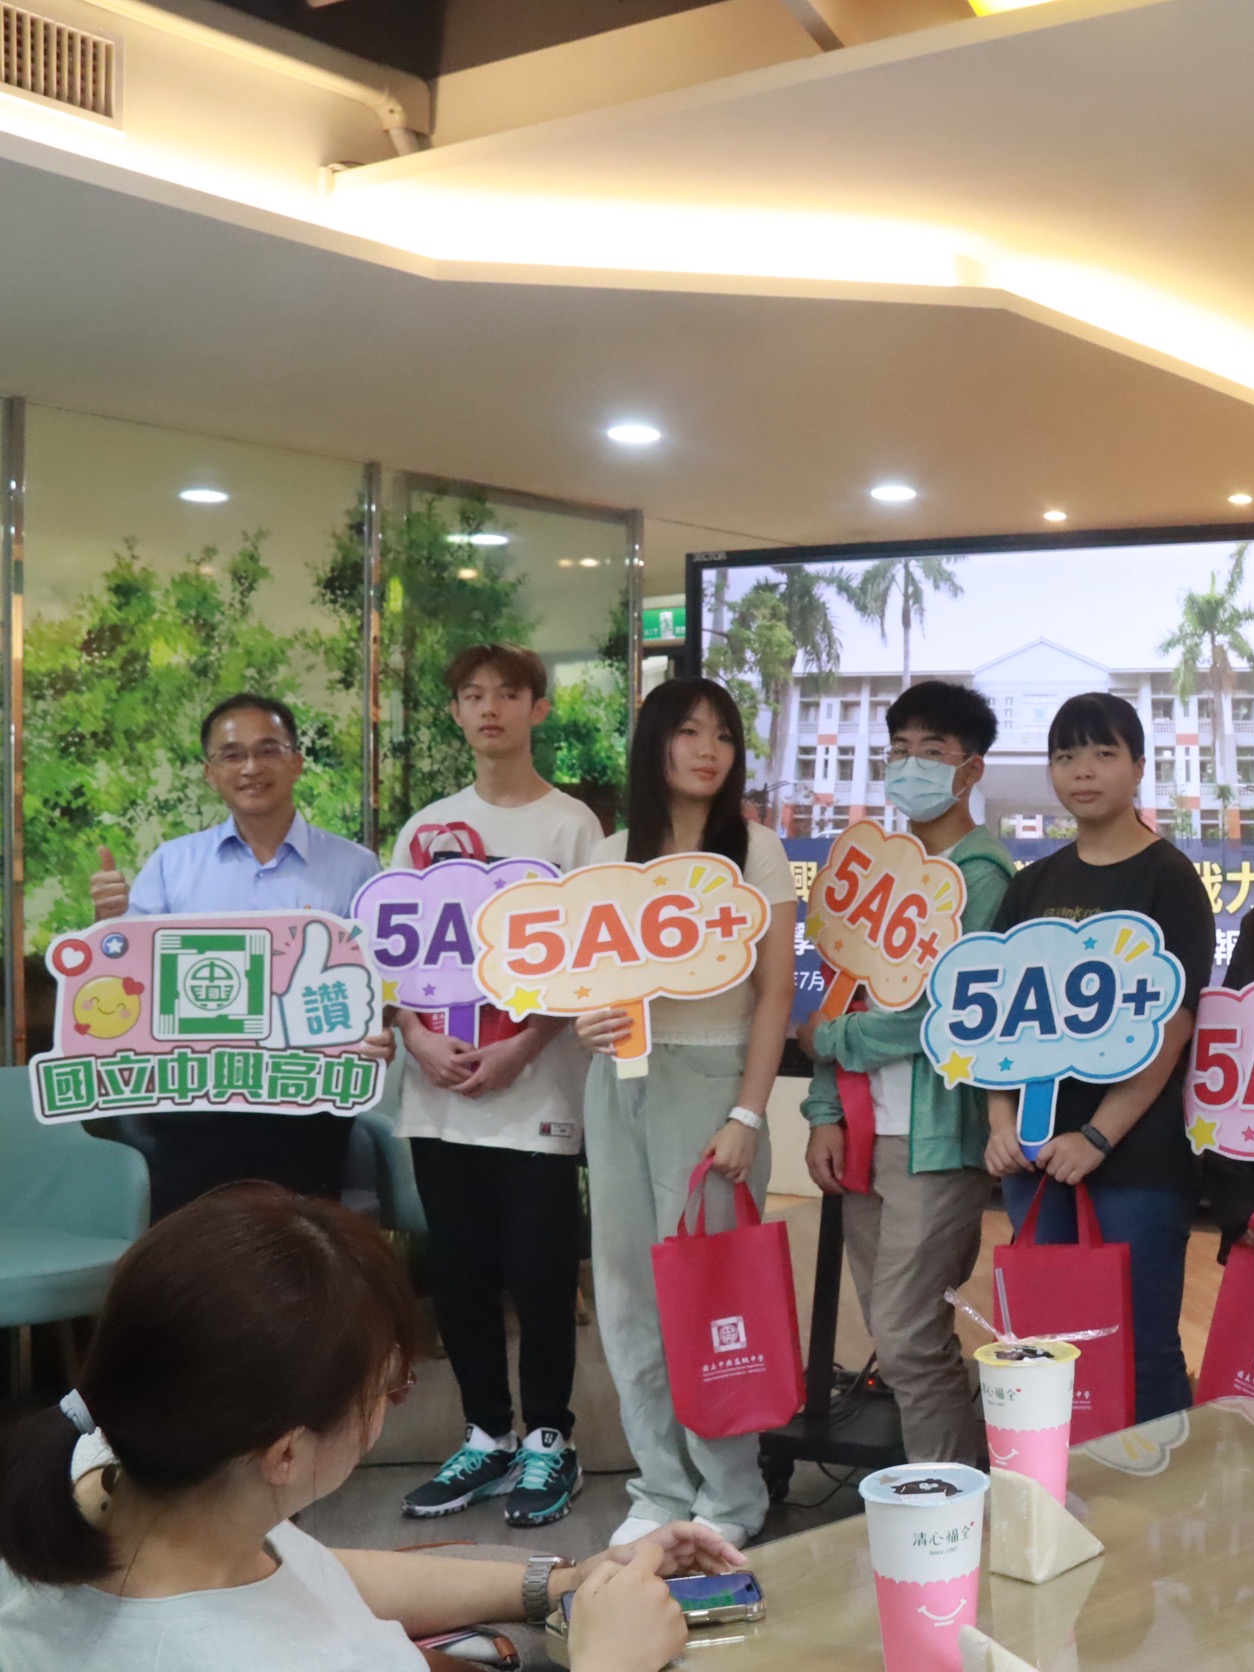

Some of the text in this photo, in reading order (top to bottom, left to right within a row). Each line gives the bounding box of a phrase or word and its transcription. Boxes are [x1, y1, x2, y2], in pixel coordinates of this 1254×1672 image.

[507, 894, 747, 976] 5A6+
[825, 845, 939, 965] 5A6+
[302, 980, 353, 1036] 讚
[949, 960, 1162, 1042] 5A9+
[42, 1050, 377, 1113] 國立中興高中
[913, 1525, 970, 1547] 清心福全
